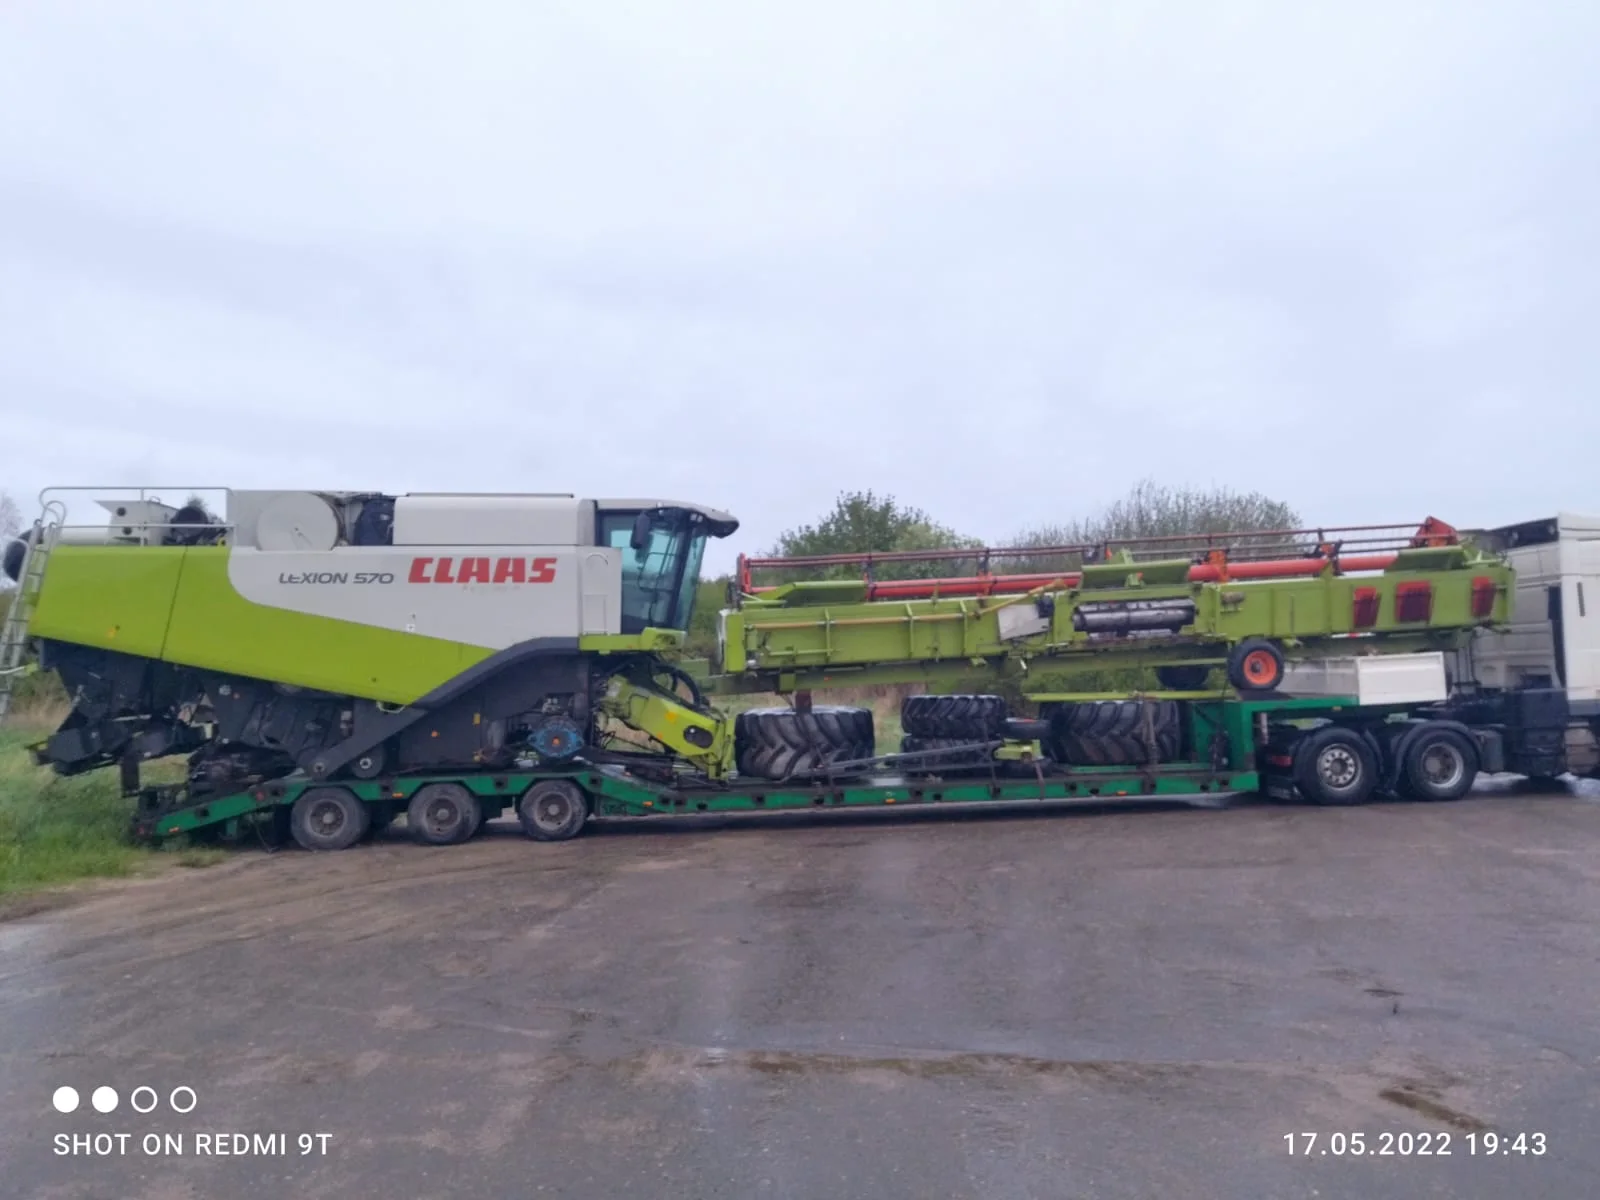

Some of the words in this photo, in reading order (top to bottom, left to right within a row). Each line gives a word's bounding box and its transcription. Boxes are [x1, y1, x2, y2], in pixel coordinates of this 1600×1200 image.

[279, 572, 348, 585] LEXION
[353, 572, 394, 585] 570
[408, 557, 557, 584] CLAAS
